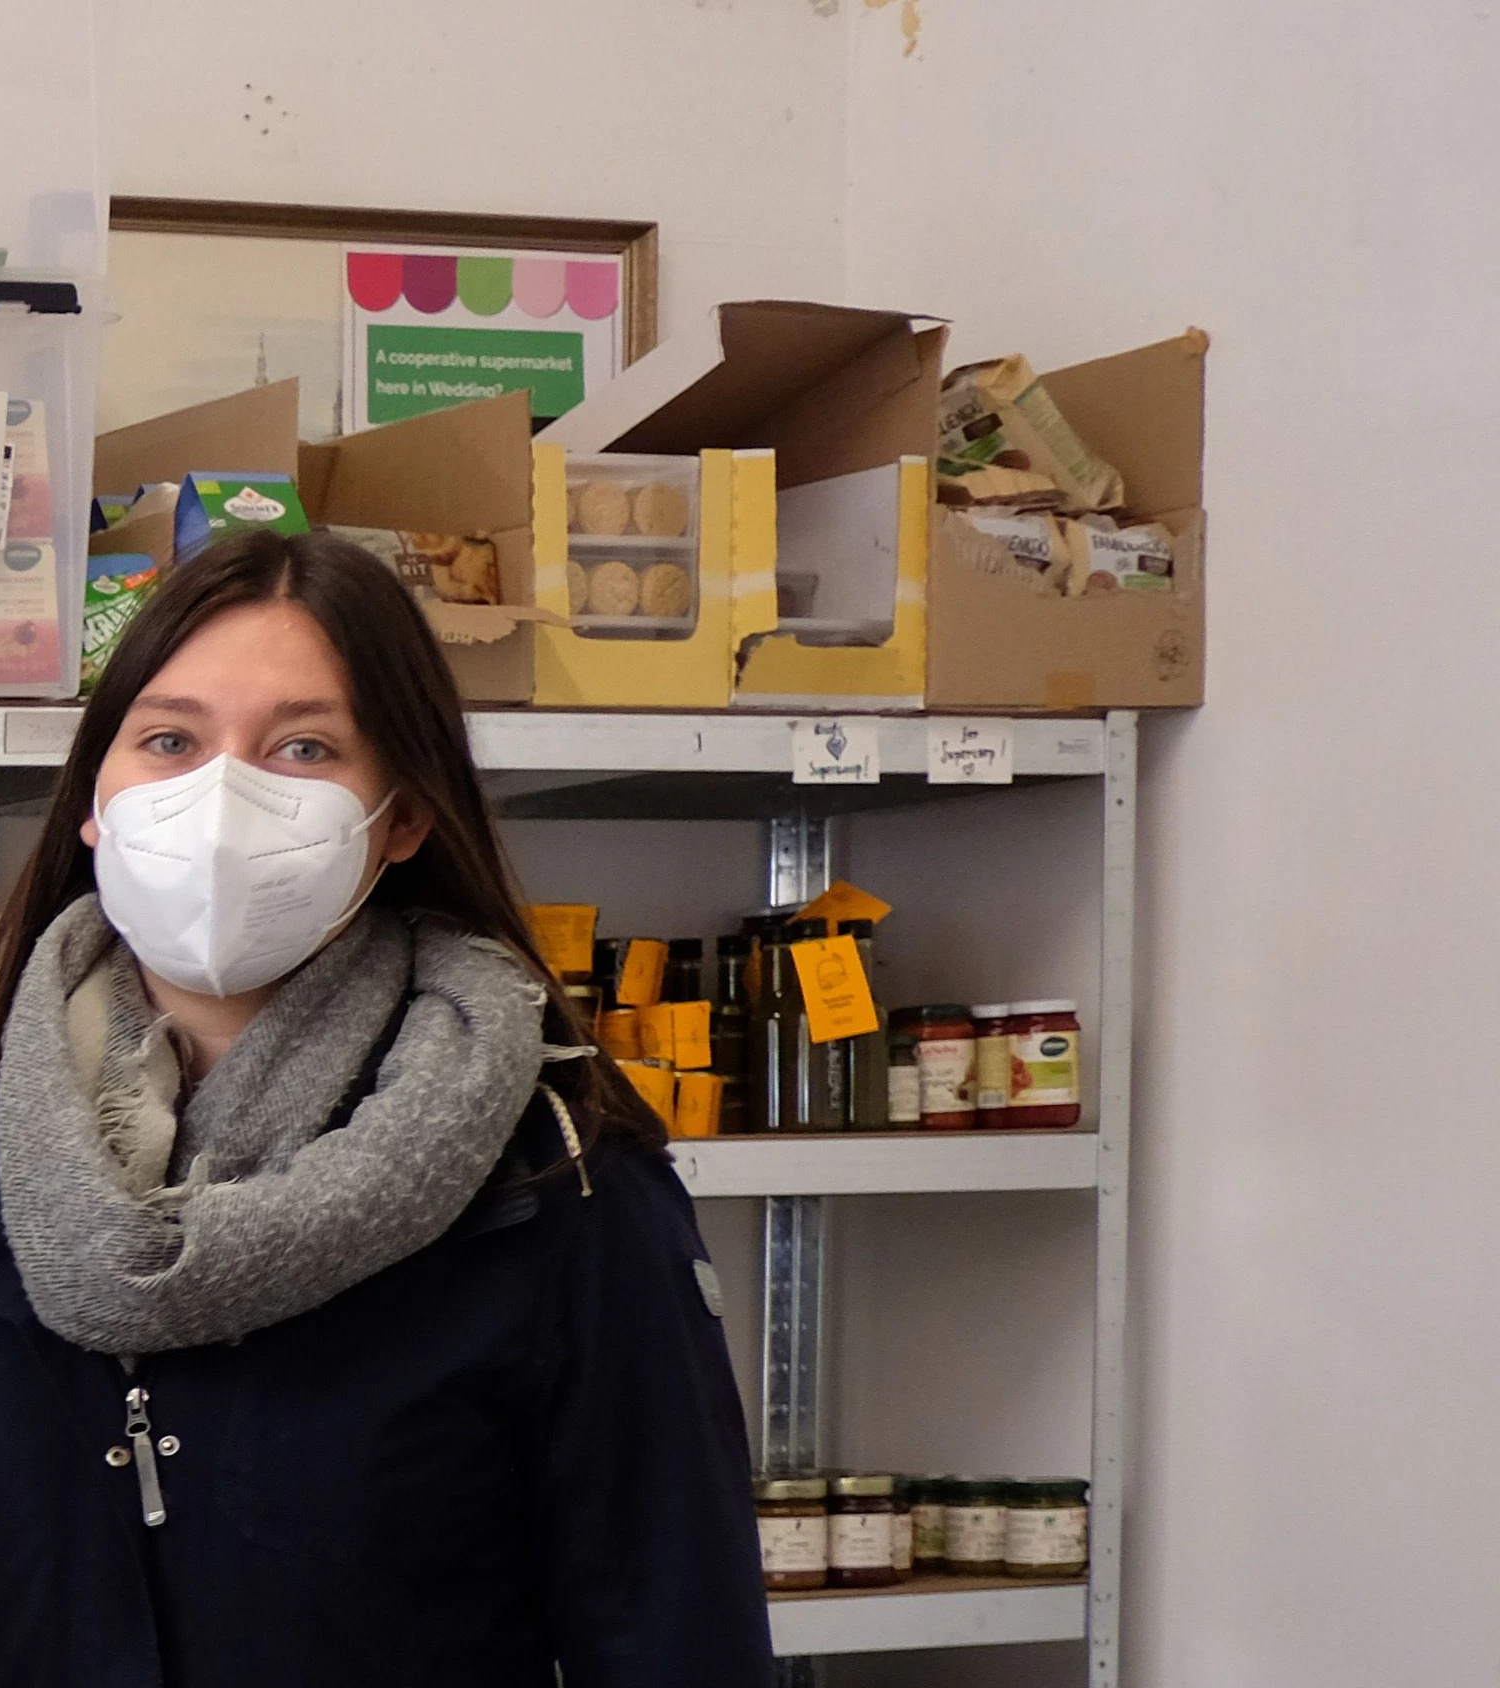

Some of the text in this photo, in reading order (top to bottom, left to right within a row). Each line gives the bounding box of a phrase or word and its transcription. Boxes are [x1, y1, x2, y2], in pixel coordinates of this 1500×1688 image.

[375, 350, 573, 371] A cooperative supermarket
[375, 379, 410, 396] here
[411, 380, 427, 395] in
